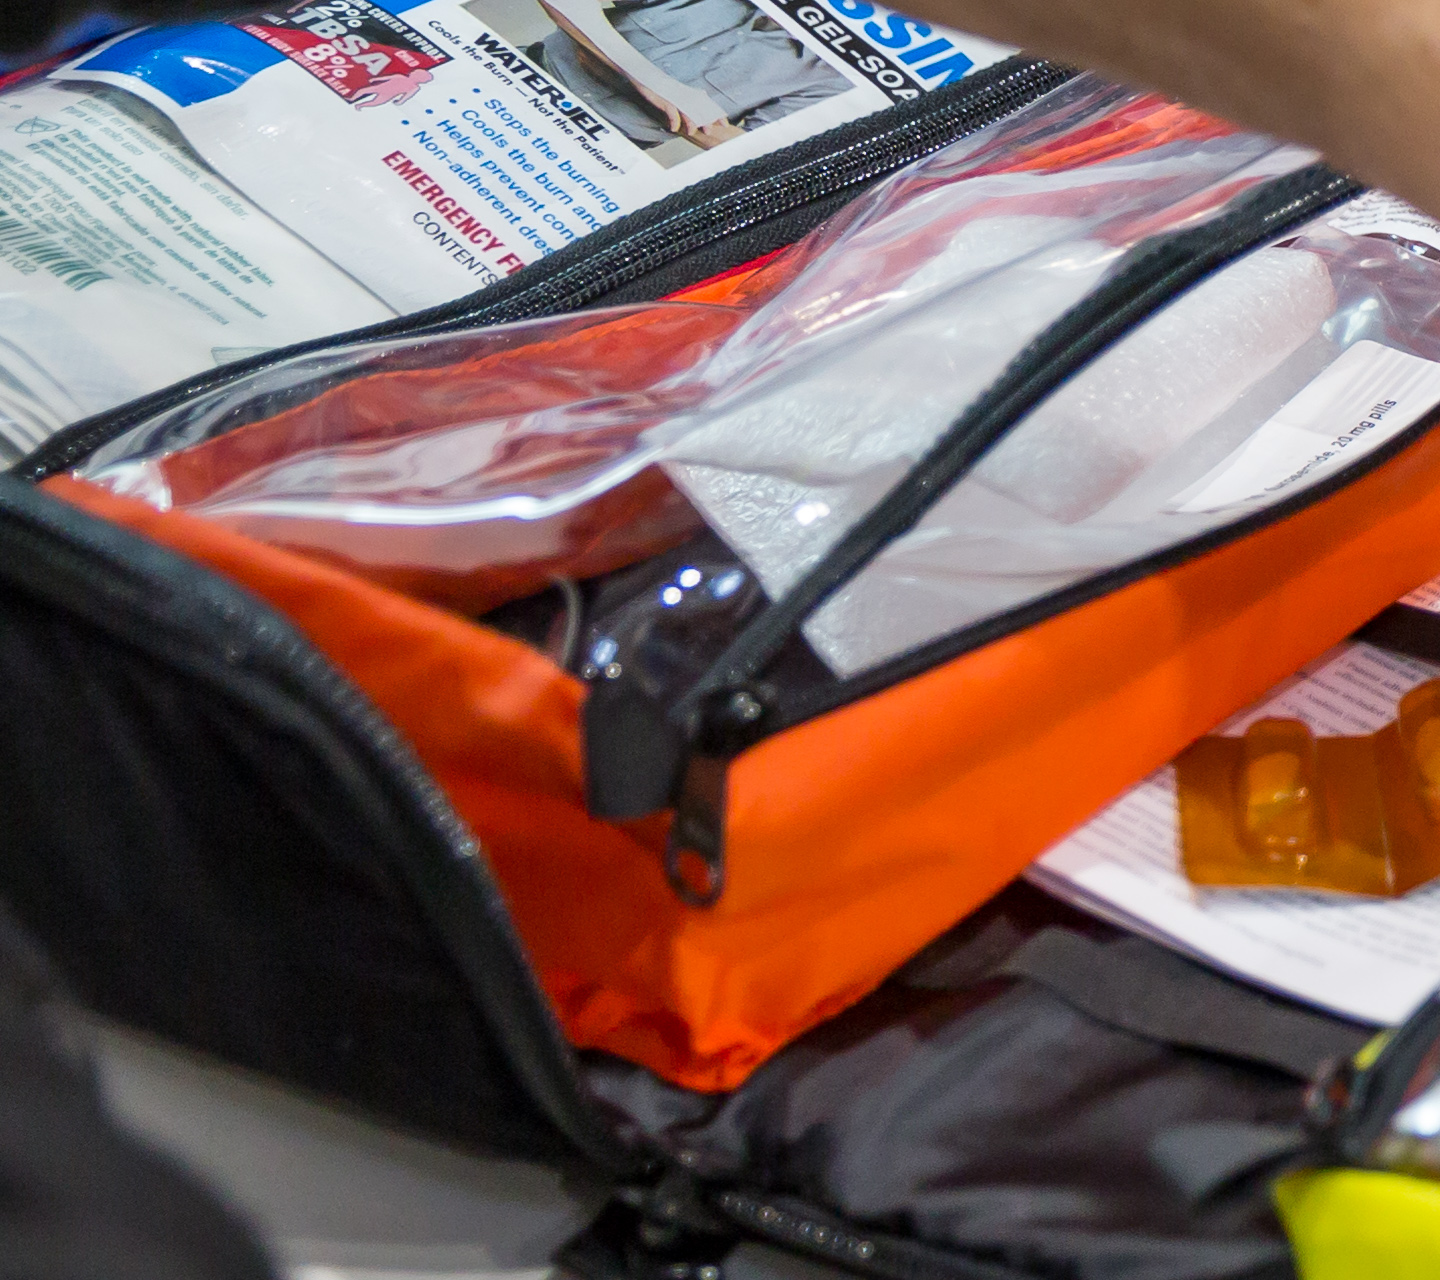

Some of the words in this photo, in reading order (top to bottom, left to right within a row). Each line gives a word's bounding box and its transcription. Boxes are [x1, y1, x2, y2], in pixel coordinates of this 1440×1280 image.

[291, 7, 392, 76] TBSA
[427, 18, 462, 47] Cools
[461, 43, 483, 65] the
[481, 56, 514, 88] Burn
[527, 96, 552, 123] Not
[381, 150, 503, 253] EMERGENCY
[412, 129, 521, 228] Non-adherent
[435, 118, 481, 161] Helps
[479, 158, 547, 219] prevent
[460, 108, 510, 151] Cools
[509, 148, 537, 176] the
[534, 166, 576, 205] burn
[483, 98, 533, 140] Stops
[533, 134, 562, 161] the
[556, 156, 622, 216] burning
